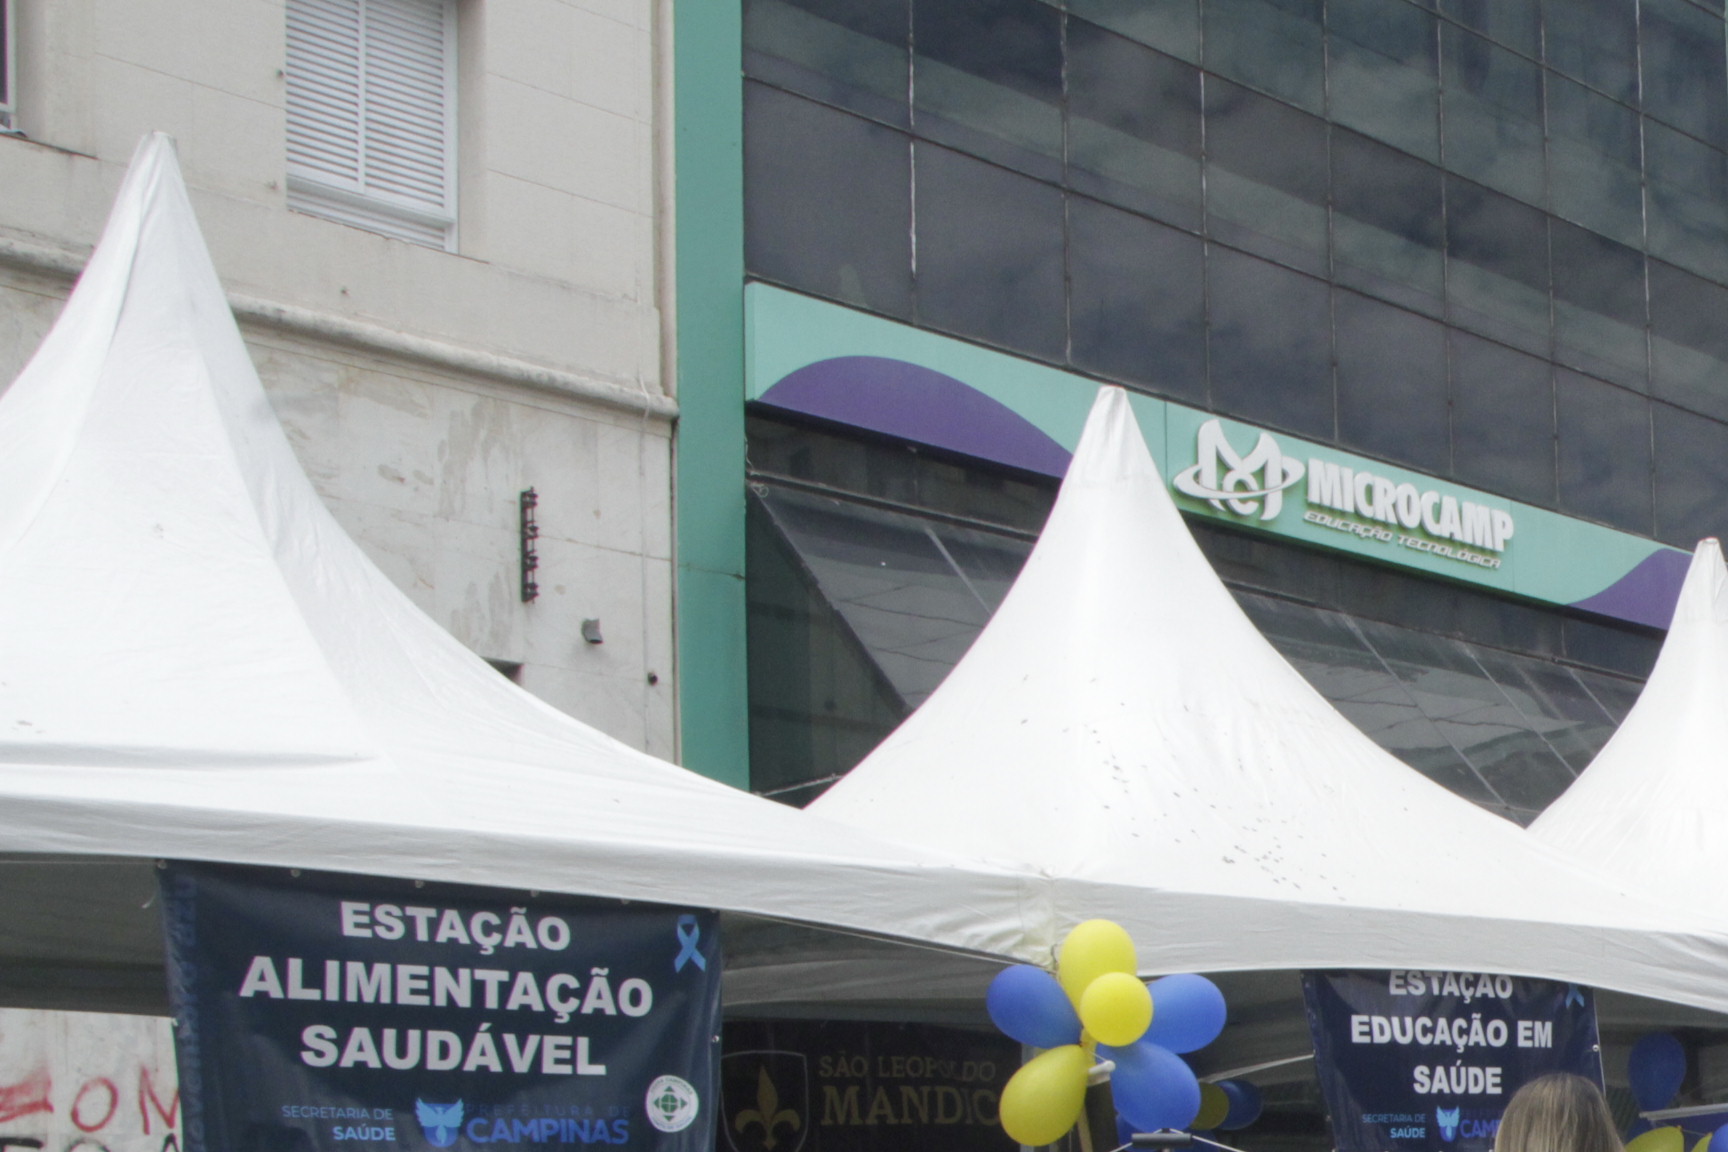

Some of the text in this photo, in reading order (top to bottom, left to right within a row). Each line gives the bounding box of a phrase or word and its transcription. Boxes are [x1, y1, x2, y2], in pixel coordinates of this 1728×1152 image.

[1305, 457, 1514, 553] MICROCAMP
[1303, 510, 1501, 569] EDUCAÇÃO TECNOLÓGICA
[340, 901, 571, 955] ESTAÇÃO
[239, 955, 653, 1025] ALIMENTAÇÃO
[300, 1022, 607, 1076] SAUDÁVEL
[1351, 1013, 1553, 1054] EDUCAÇÃO EM
[818, 1049, 870, 1079] SÃO
[1413, 1060, 1503, 1095] SAÚDE
[282, 1105, 394, 1120] SECRETARIA DE
[332, 1121, 397, 1141] SAÚDE
[466, 1117, 630, 1145] CAMPINAS
[1390, 1126, 1426, 1139] SAÚDE
